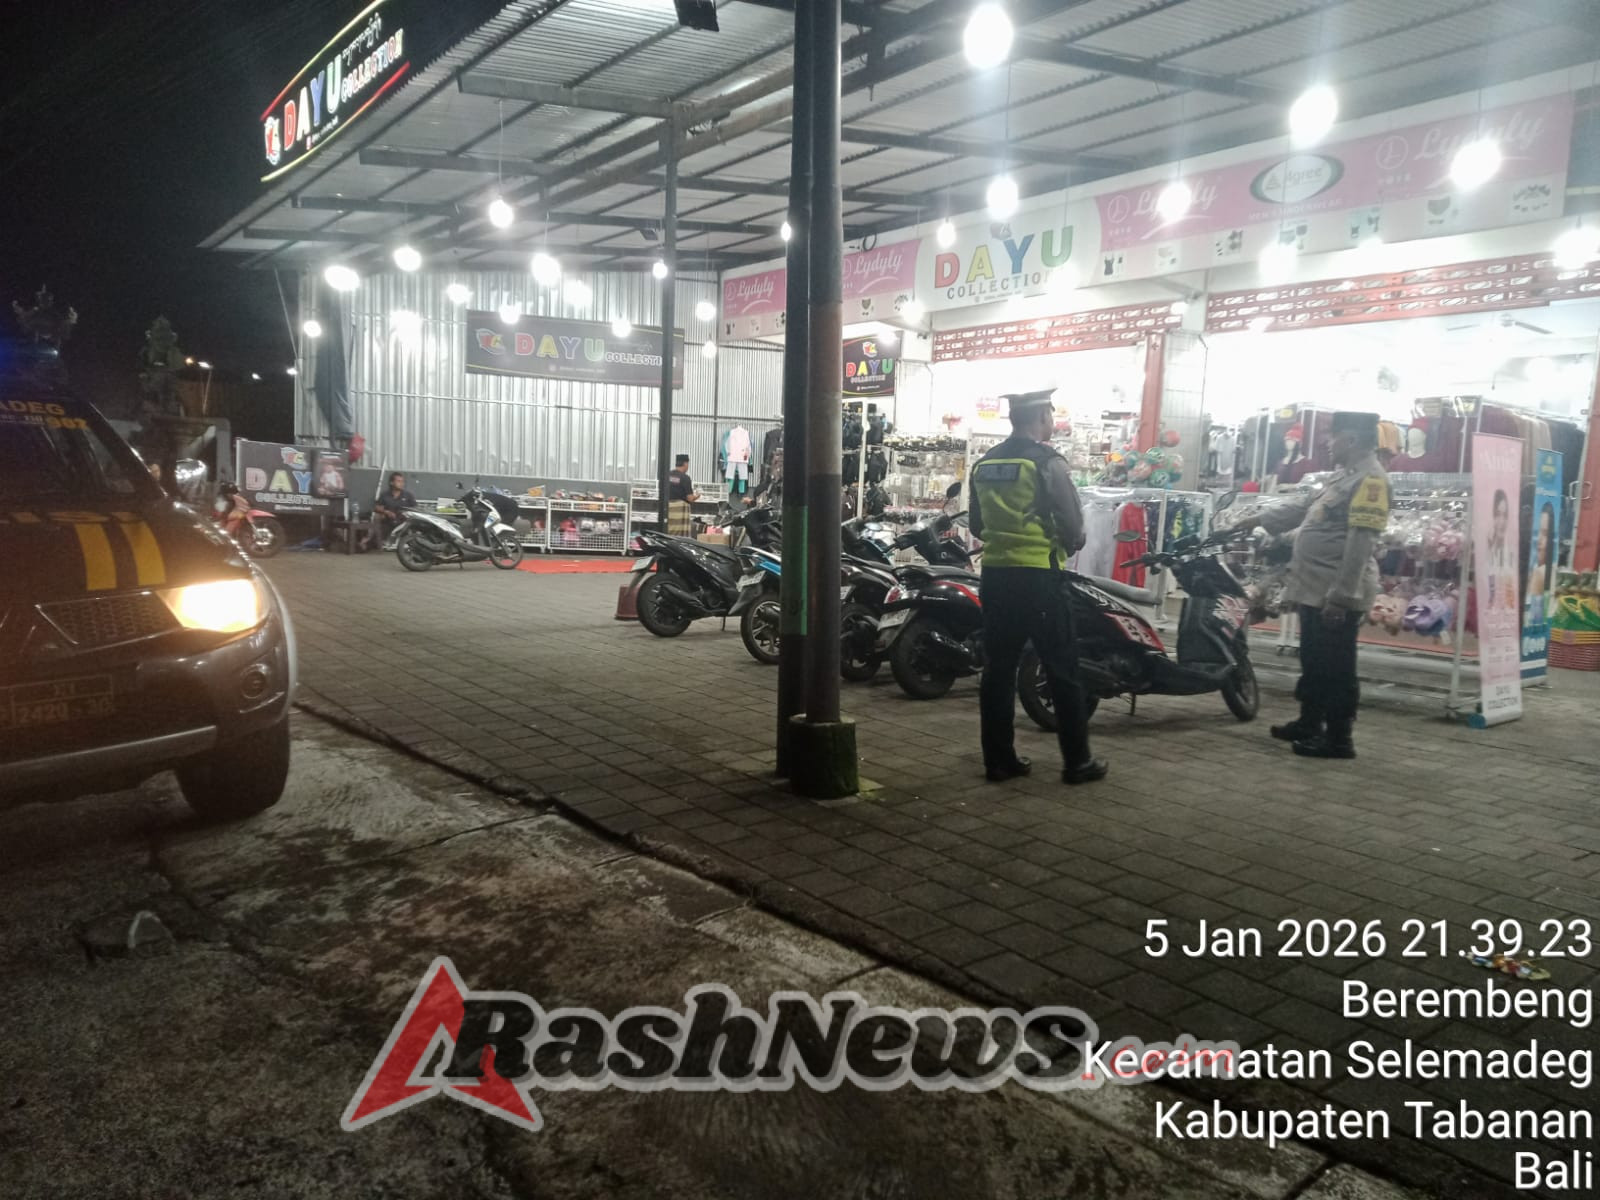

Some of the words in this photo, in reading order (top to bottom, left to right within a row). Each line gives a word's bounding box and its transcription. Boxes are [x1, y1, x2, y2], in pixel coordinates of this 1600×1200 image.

[283, 54, 342, 151] DAYU
[934, 225, 1074, 289] DAYU
[514, 332, 605, 362] DAYU
[846, 358, 893, 378] DAYU
[245, 467, 313, 494] DAY
